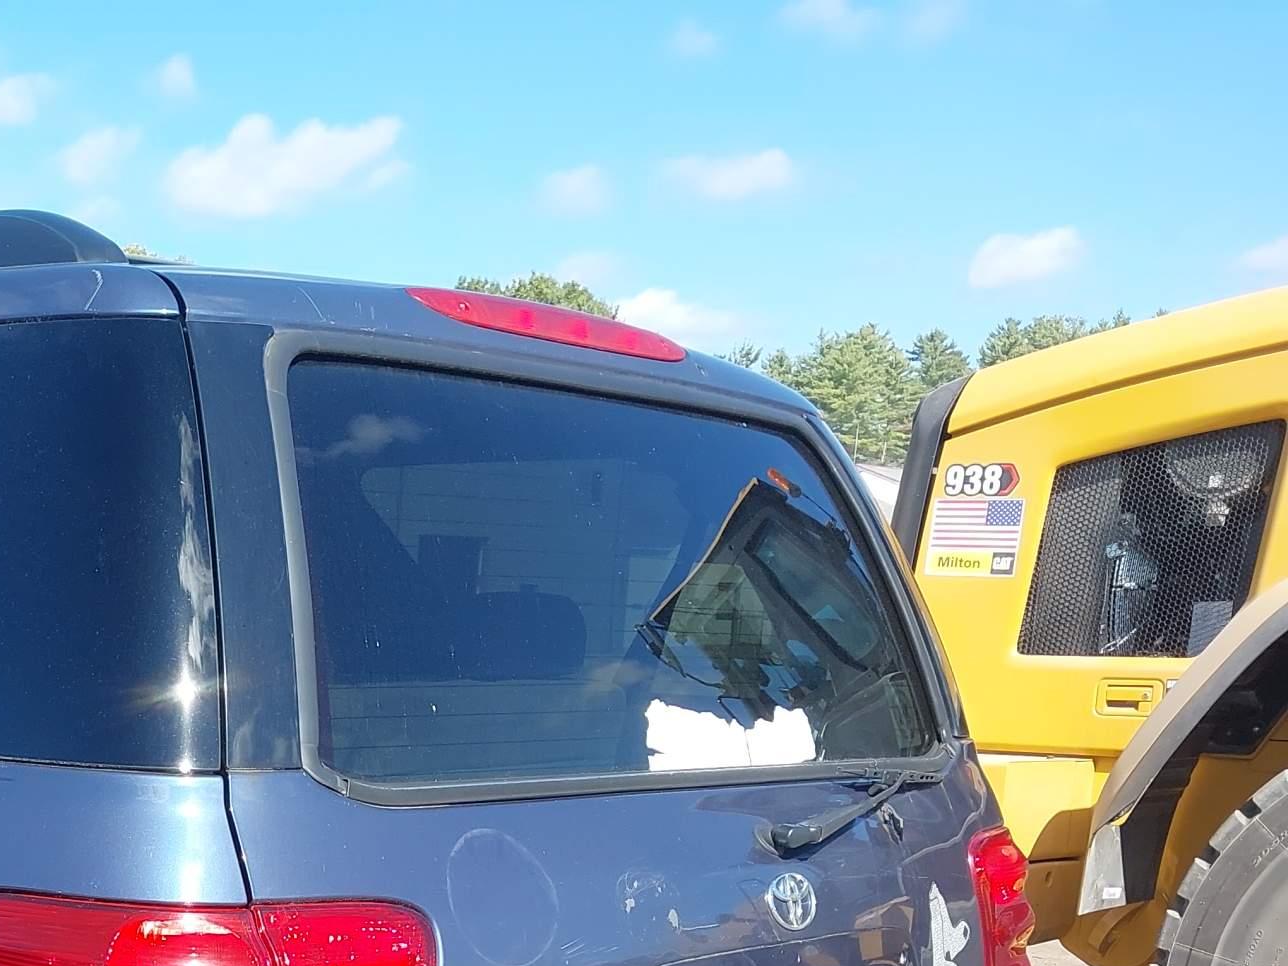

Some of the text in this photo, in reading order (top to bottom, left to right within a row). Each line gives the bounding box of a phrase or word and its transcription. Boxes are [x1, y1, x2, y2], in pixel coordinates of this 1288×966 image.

[944, 464, 1003, 497] 938
[937, 556, 981, 569] Milton
[992, 557, 1014, 571] CAT
